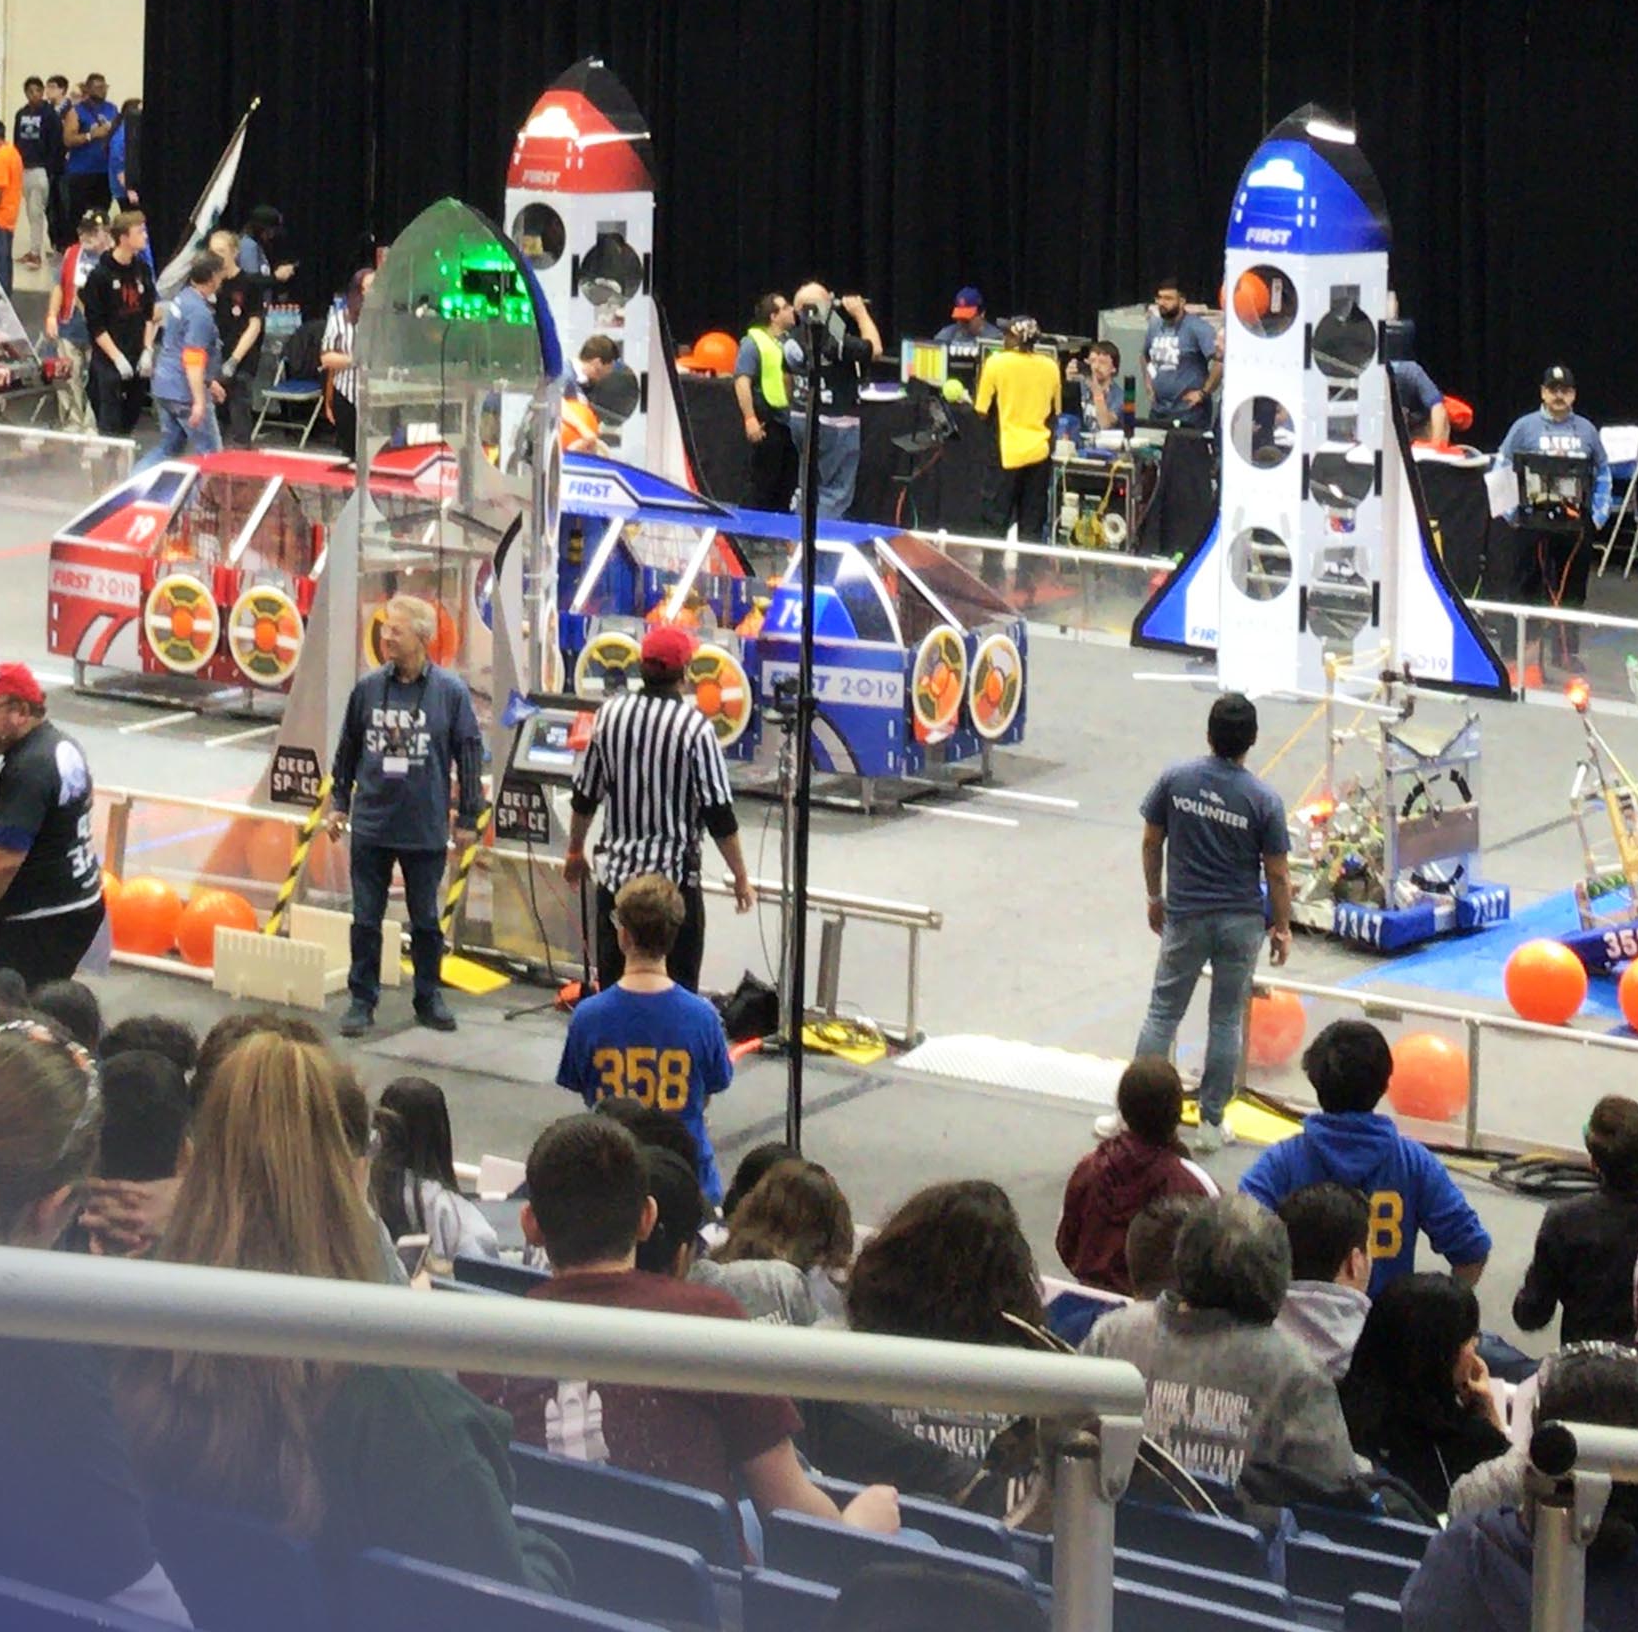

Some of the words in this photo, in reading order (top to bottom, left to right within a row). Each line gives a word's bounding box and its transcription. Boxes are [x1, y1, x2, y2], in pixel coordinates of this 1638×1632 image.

[522, 170, 561, 187] FIRST
[1245, 227, 1292, 246] FIRST
[567, 479, 612, 498] FIRST
[126, 514, 157, 542] 19
[53, 568, 93, 591] FIRST
[97, 575, 137, 599] 2019
[840, 675, 899, 699] 2019
[366, 730, 432, 756] SPCE
[277, 755, 316, 772] DEEP
[273, 772, 320, 793] SPCE
[502, 790, 542, 808] DEEP
[498, 807, 548, 832] SPCE
[1172, 795, 1249, 831] VOLUNTEER
[1338, 908, 1383, 949] 2347
[593, 1046, 693, 1112] 358
